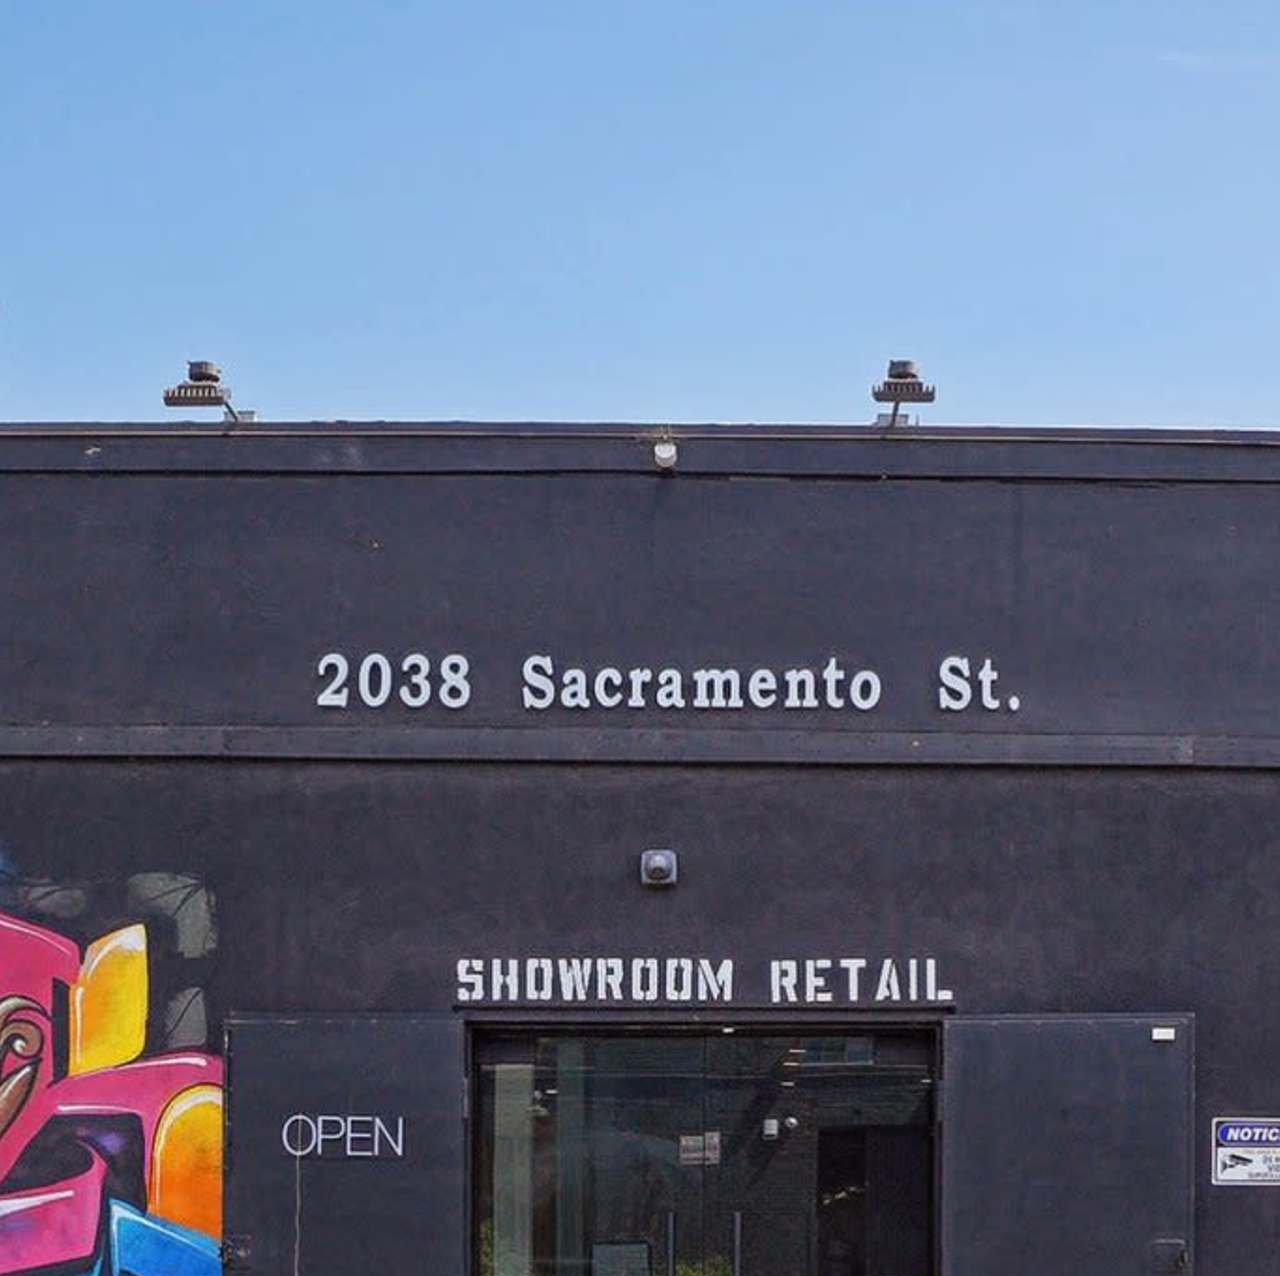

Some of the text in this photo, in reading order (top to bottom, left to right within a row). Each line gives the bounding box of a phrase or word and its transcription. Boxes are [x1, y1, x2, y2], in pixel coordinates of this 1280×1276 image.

[317, 652, 1020, 711] 2038 Sacramento St.
[457, 957, 953, 1003] SHOWROOM RETAIL
[281, 1114, 404, 1157] OPEN
